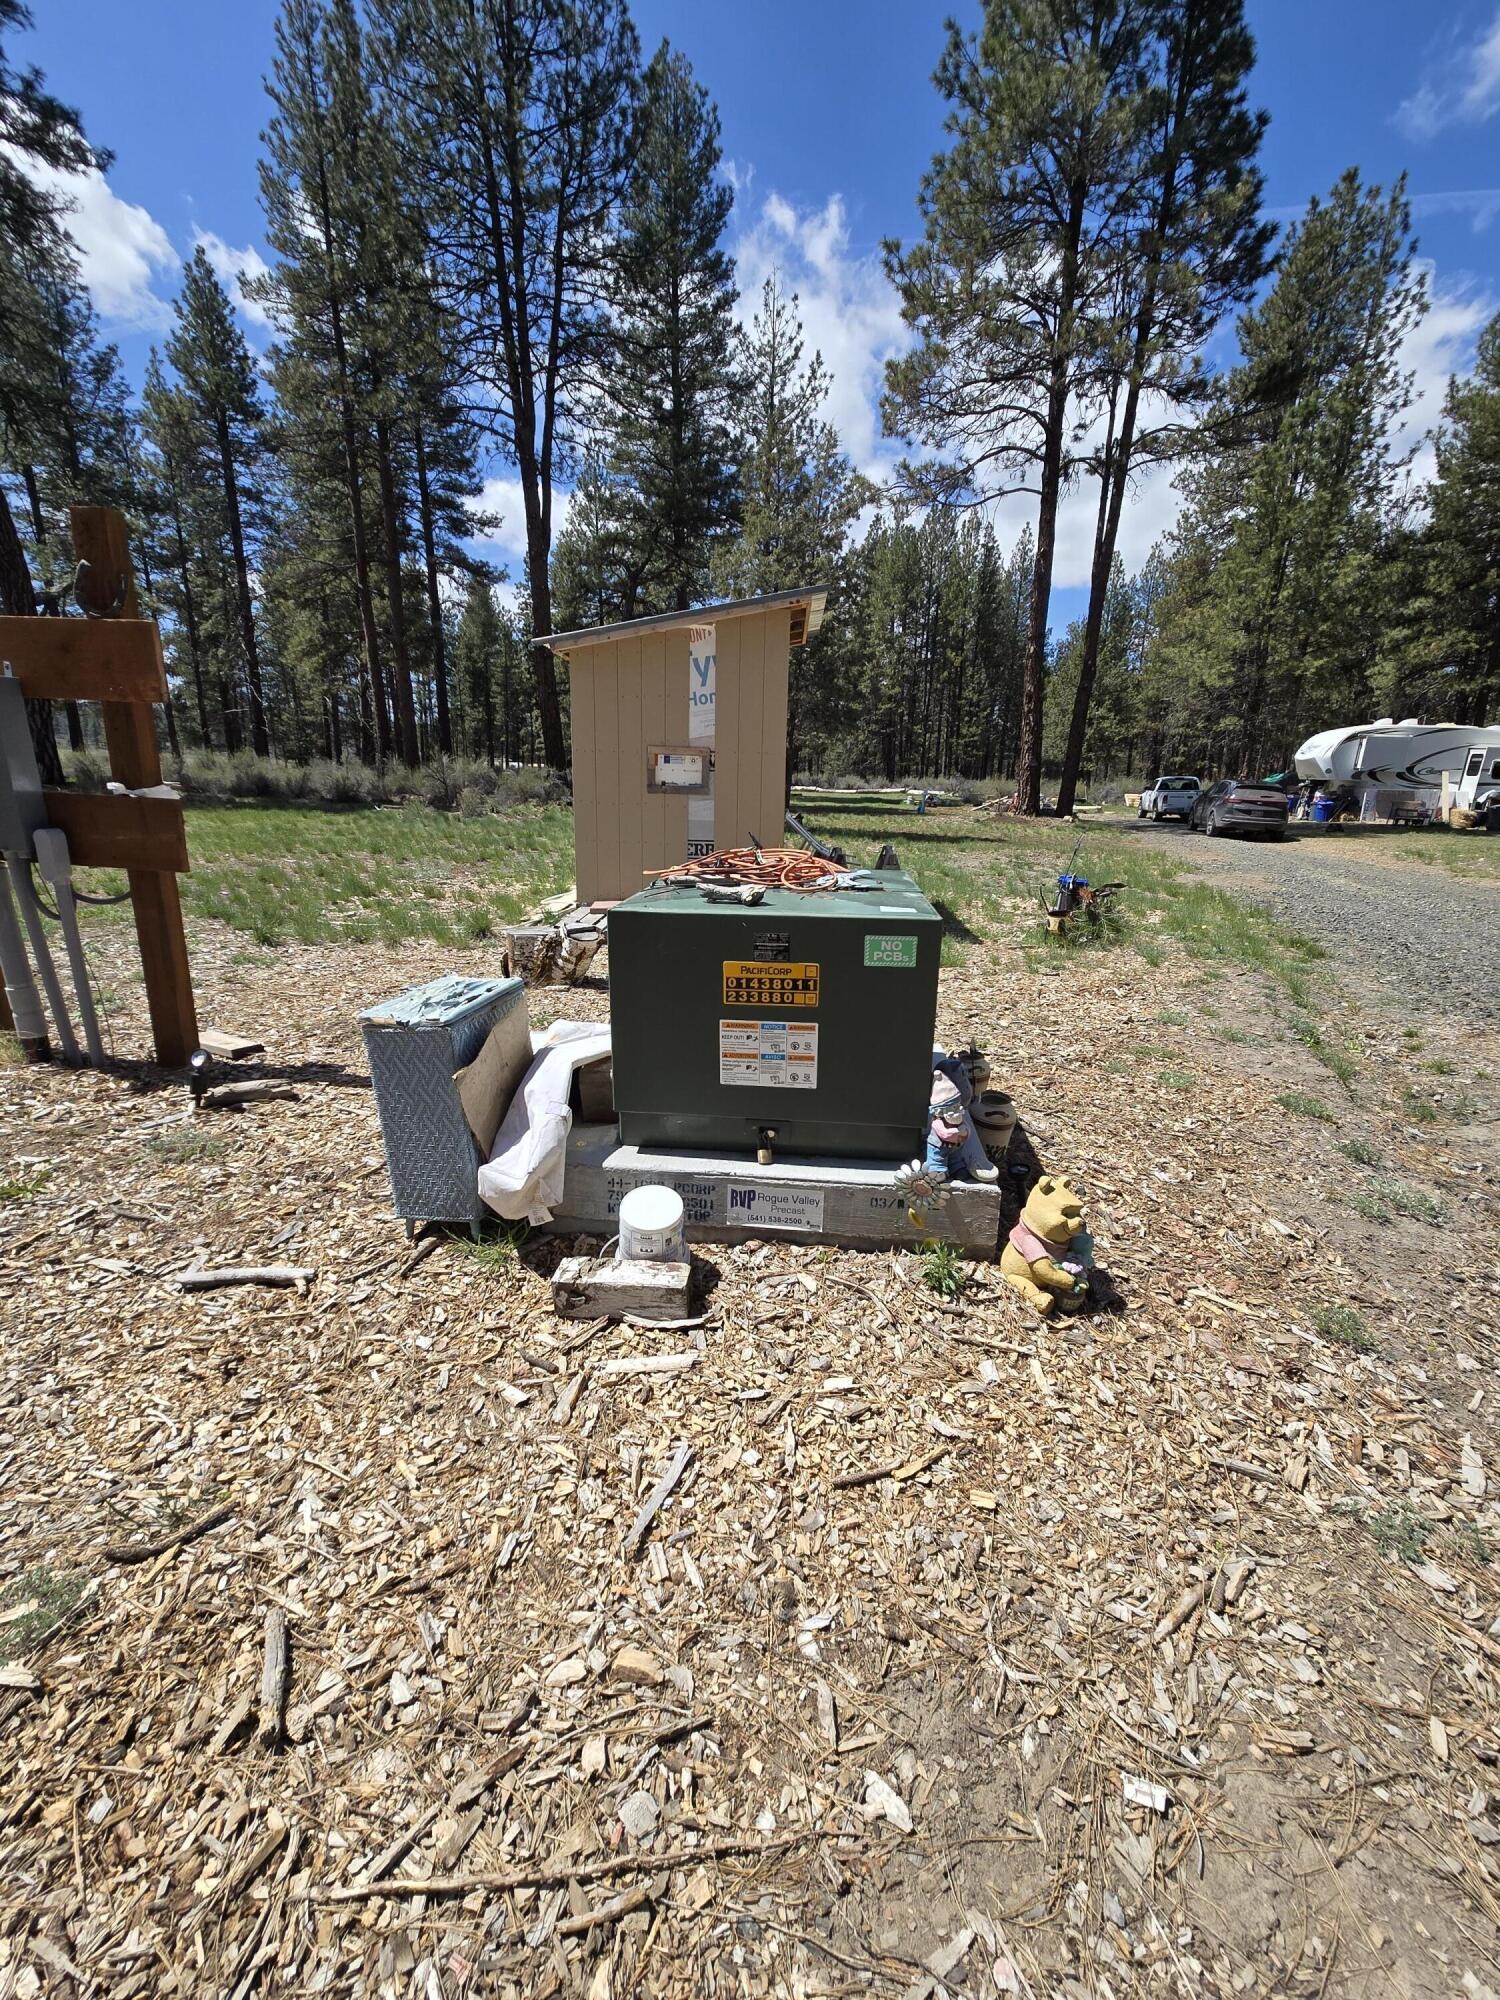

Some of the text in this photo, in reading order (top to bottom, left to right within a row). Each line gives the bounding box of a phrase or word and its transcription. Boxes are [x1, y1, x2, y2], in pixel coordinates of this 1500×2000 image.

[880, 940, 903, 951] NO
[873, 951, 910, 962] PCBs
[727, 976, 815, 990] 01438011
[727, 991, 793, 1003] 233880
[673, 1181, 716, 1195] PCORP
[730, 1188, 821, 1210] RVP Rogue Valley
[770, 1204, 806, 1215] Precast
[747, 1214, 766, 1223] (541)
